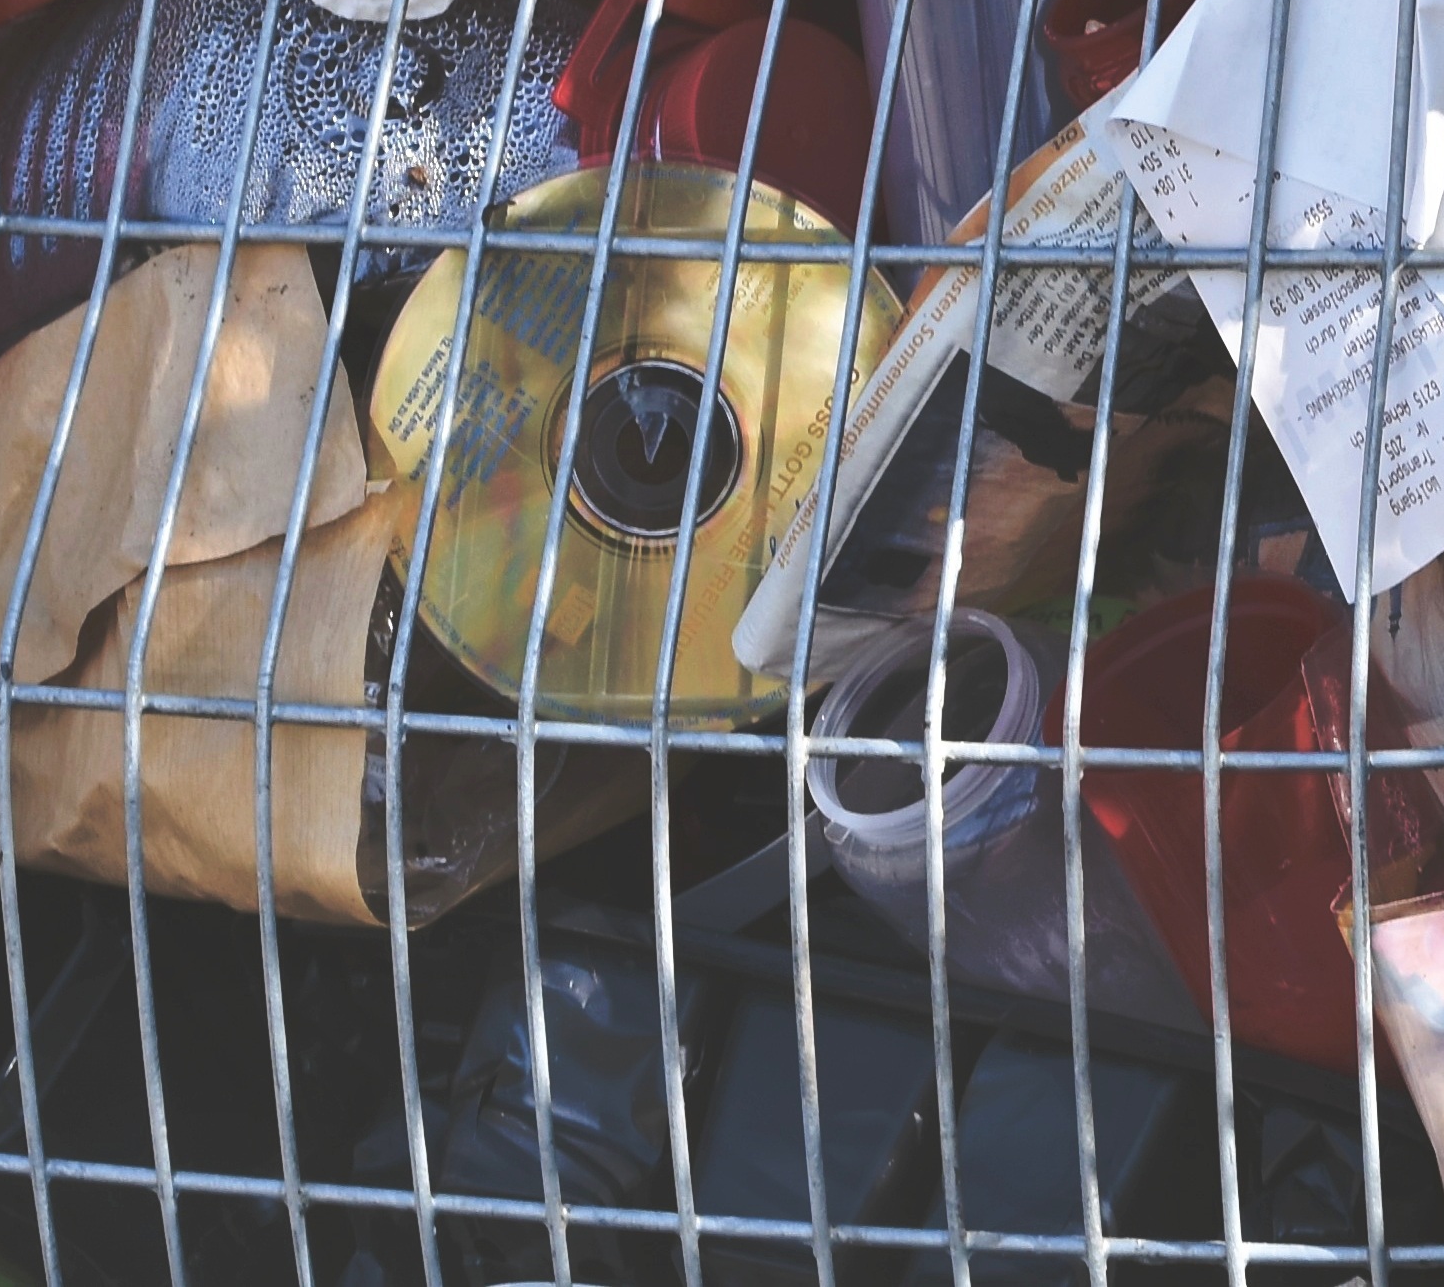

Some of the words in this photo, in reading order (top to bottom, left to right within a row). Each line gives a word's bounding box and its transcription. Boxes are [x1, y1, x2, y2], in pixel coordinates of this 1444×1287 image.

[1051, 125, 1078, 151] Ort
[1048, 148, 1099, 198] Plätze
[1028, 195, 1057, 220] für
[1301, 198, 1333, 227] 5593
[928, 258, 984, 323] önsten
[1266, 271, 1322, 317] 16:00:39
[1336, 304, 1367, 332] sind
[1398, 295, 1423, 318] aus
[1025, 323, 1045, 346] der
[1303, 324, 1338, 355] durch
[1072, 349, 1092, 372] Das
[1410, 378, 1443, 408] 6215
[1407, 418, 1431, 442] Nr.
[1381, 434, 1408, 460] 205
[1388, 474, 1443, 518] Wolfgang
[666, 565, 735, 666] FREUND
